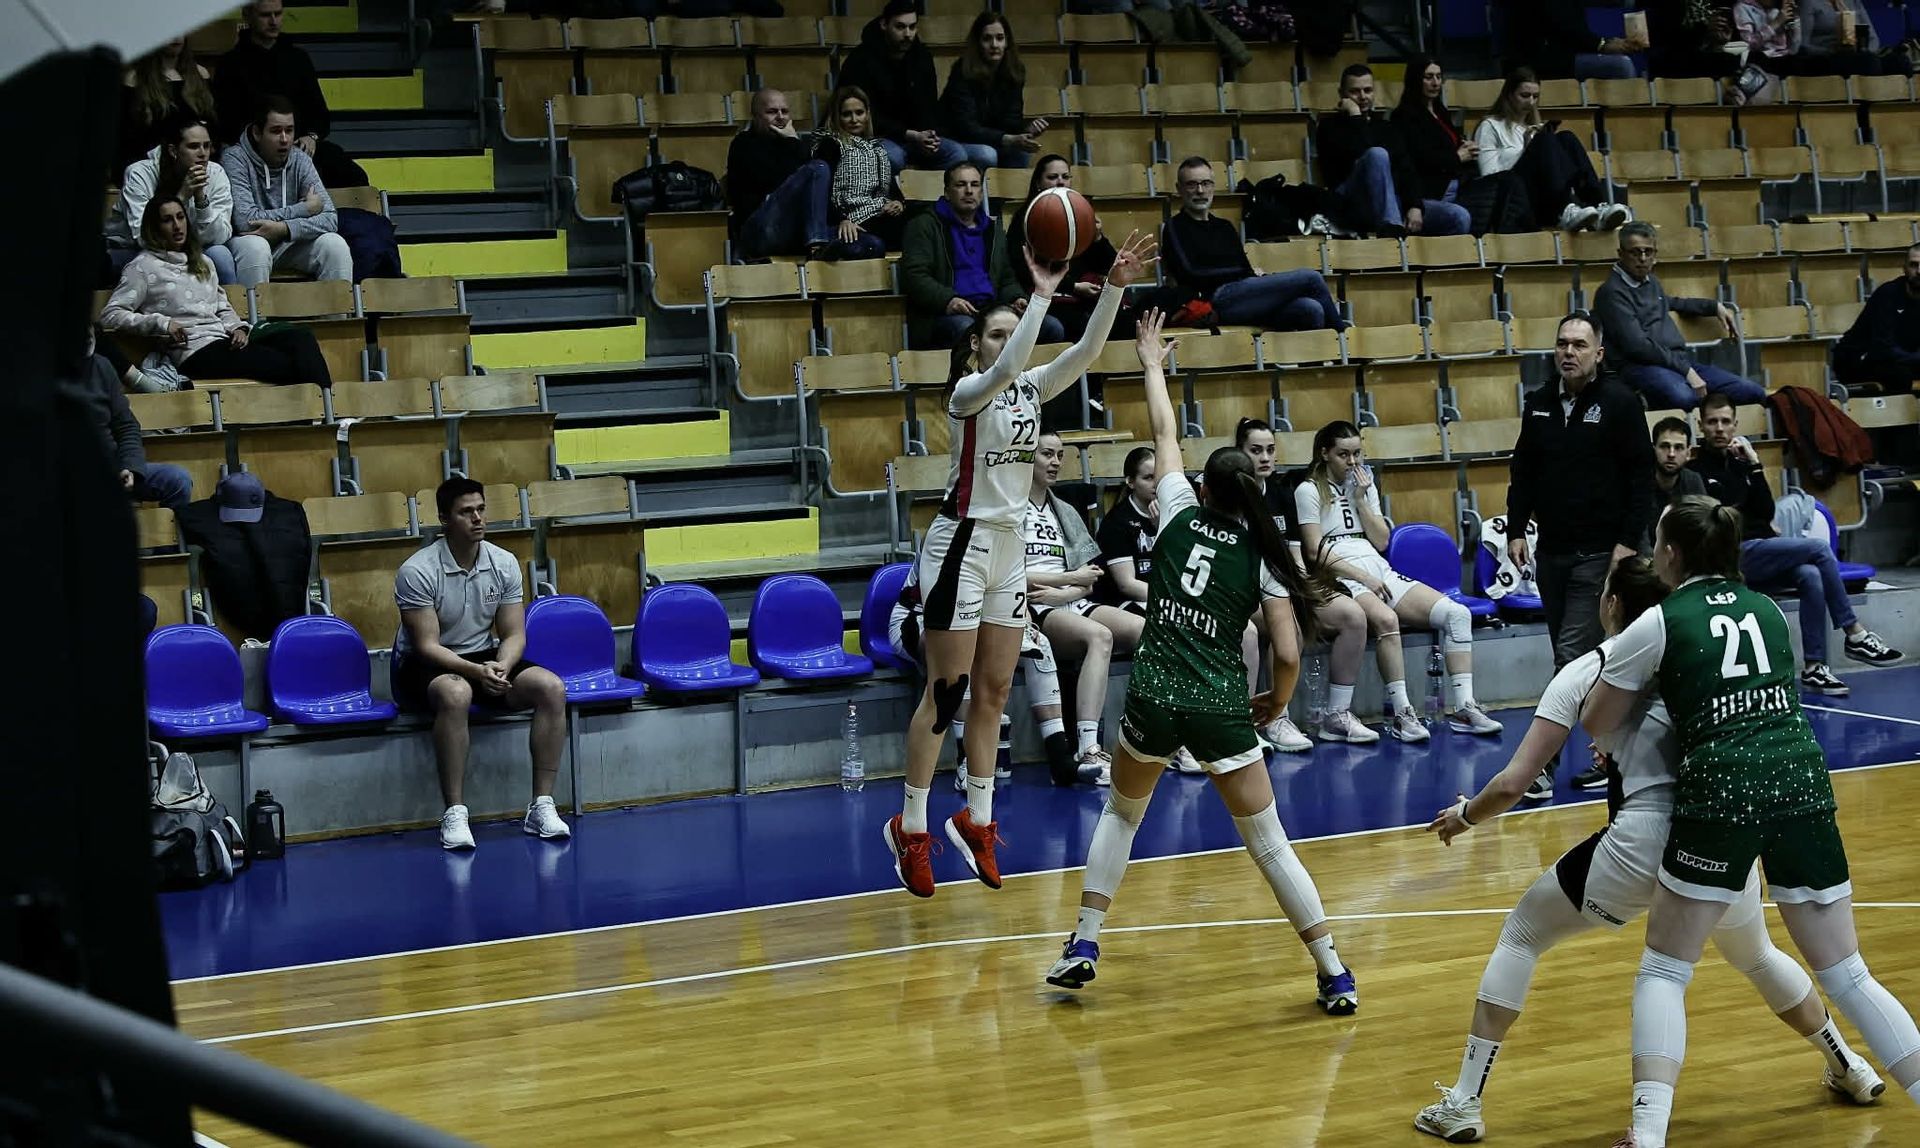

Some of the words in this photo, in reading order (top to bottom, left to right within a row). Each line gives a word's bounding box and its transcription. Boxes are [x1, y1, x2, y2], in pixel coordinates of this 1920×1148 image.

[1011, 419, 1036, 446] 22
[1189, 518, 1239, 546] GÁLOS
[1342, 509, 1354, 529] 6
[1180, 543, 1217, 597] 5
[1705, 591, 1738, 606] LÉP
[1709, 612, 1772, 680] 21
